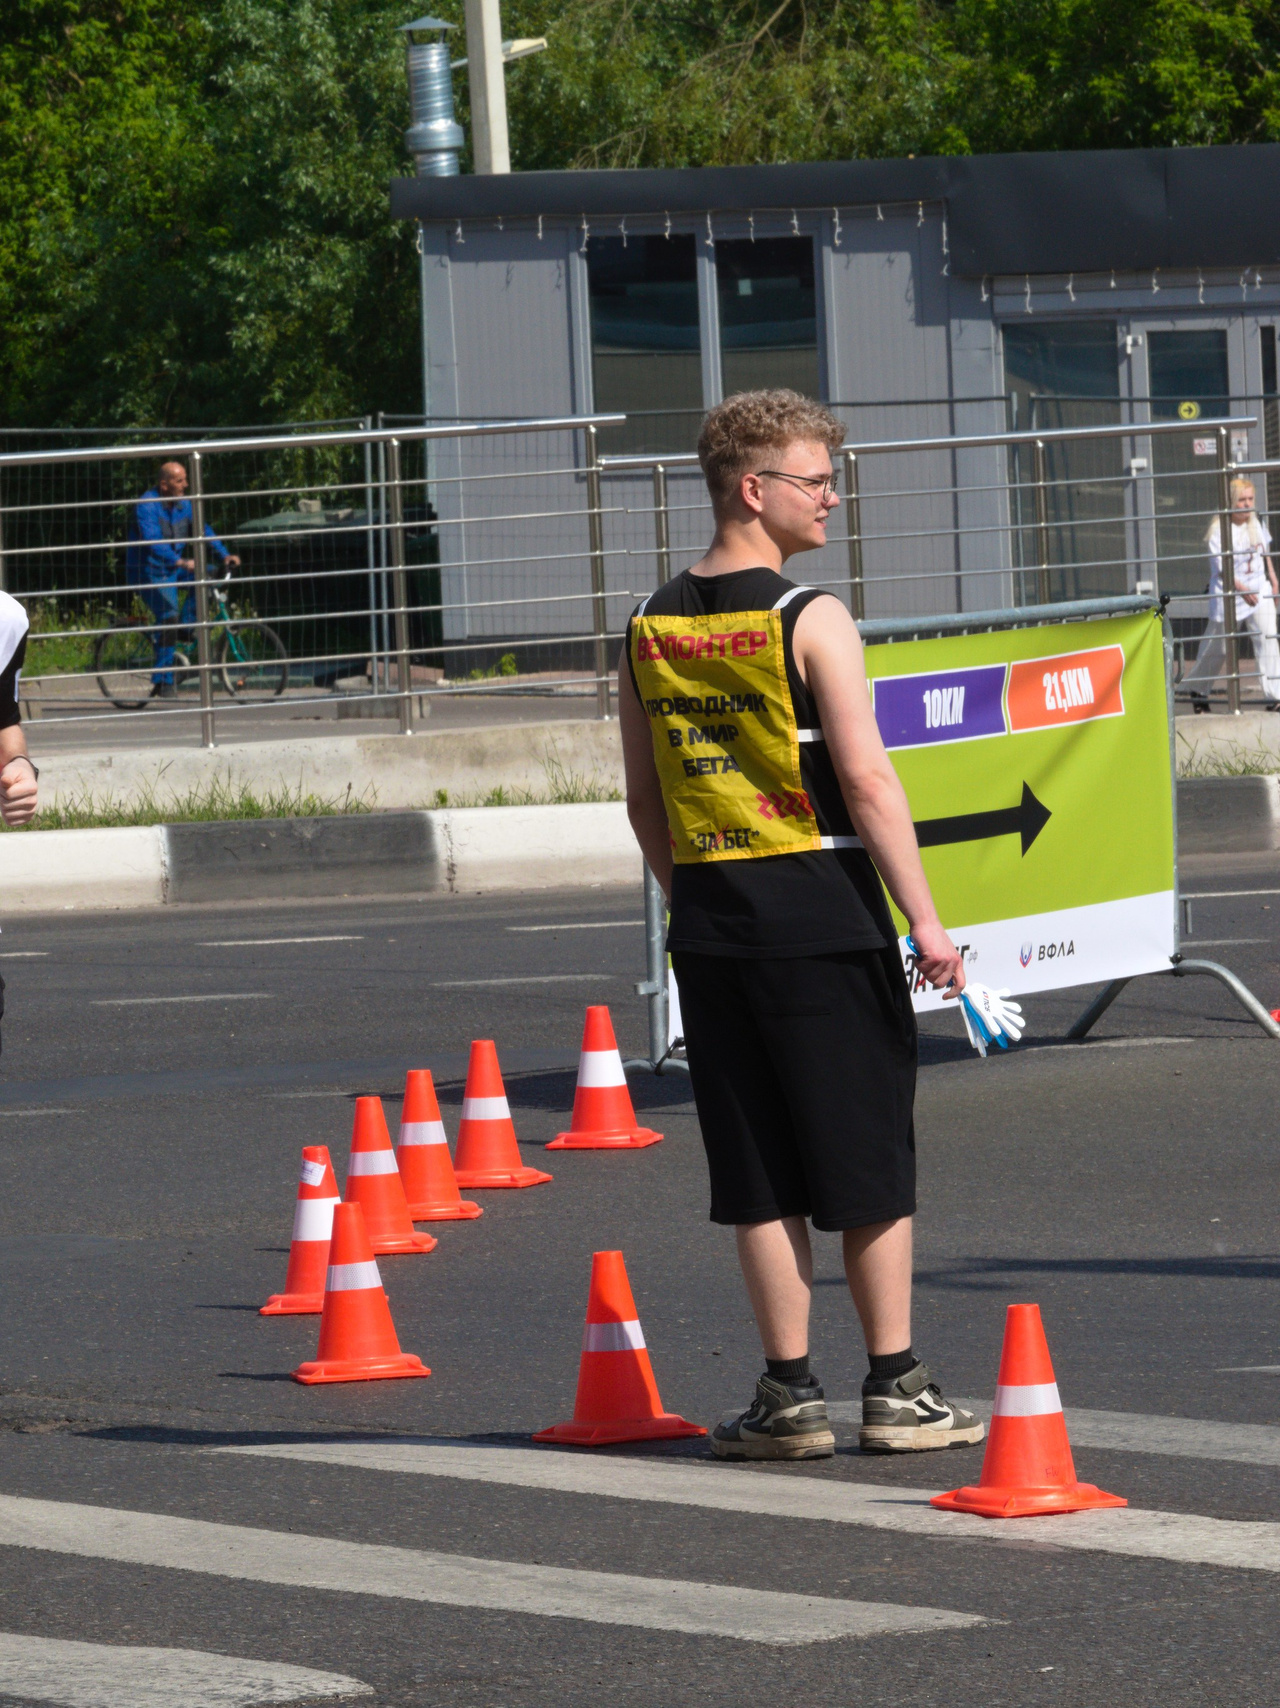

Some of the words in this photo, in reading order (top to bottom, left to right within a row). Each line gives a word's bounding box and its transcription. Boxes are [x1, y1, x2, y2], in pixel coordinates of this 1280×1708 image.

[637, 631, 768, 662] ВОЛОНТЕР
[646, 692, 769, 718] ПРОВОДНИК
[922, 686, 966, 729] 10КМ
[668, 728, 683, 748] В
[688, 723, 740, 745] МИР
[682, 755, 742, 778] БЕГА
[1038, 940, 1076, 961] ВФЛА
